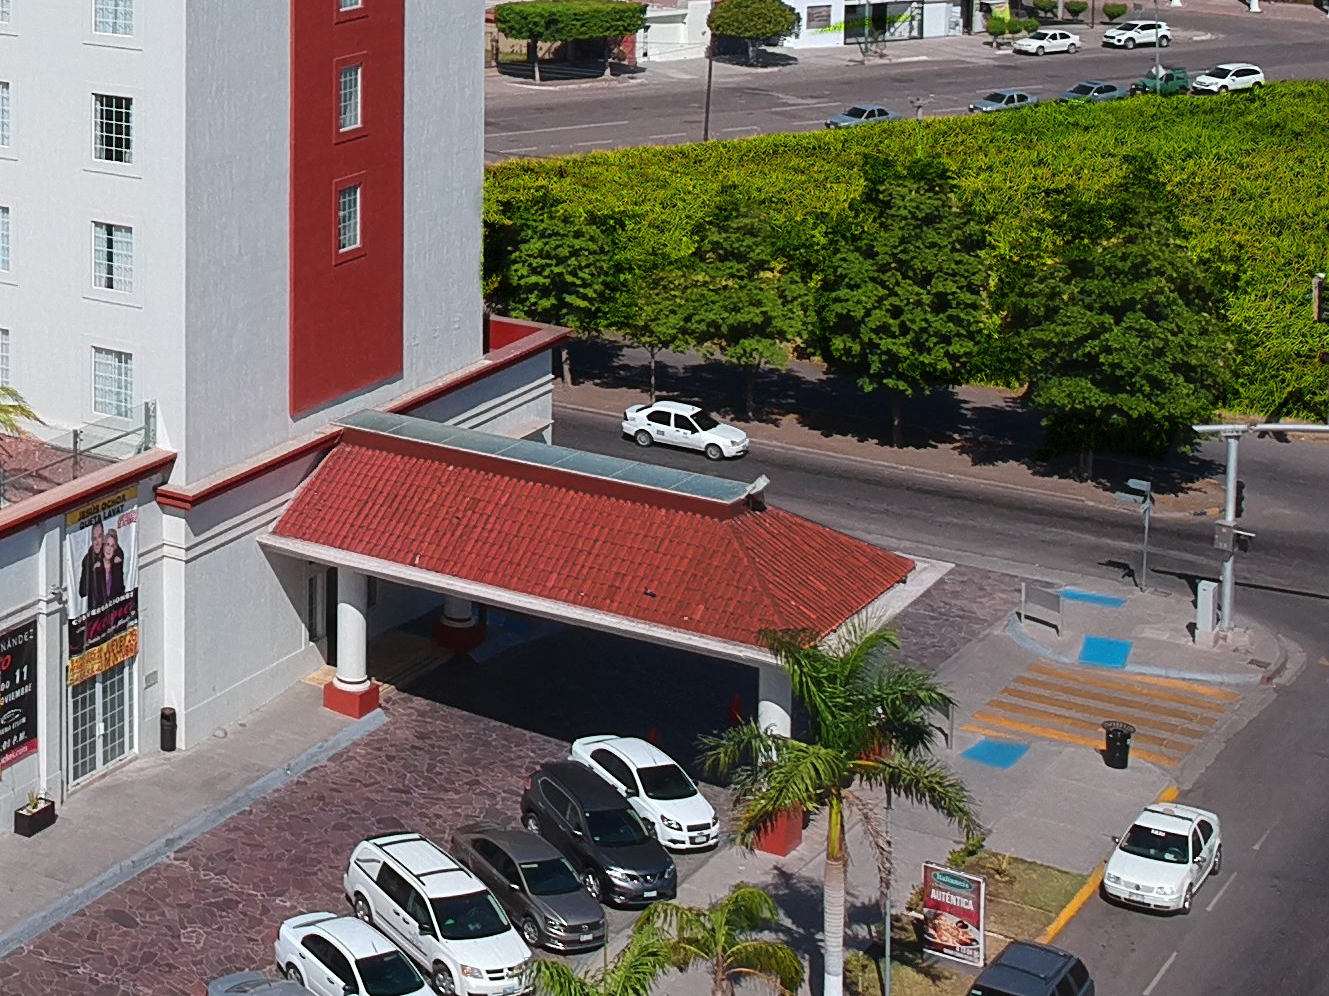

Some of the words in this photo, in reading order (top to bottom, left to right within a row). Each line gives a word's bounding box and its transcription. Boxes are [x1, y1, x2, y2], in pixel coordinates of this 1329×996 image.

[15, 664, 28, 684] 11
[0, 683, 32, 706] OVIEMBRE
[930, 888, 974, 911] AUTÉNTICA
